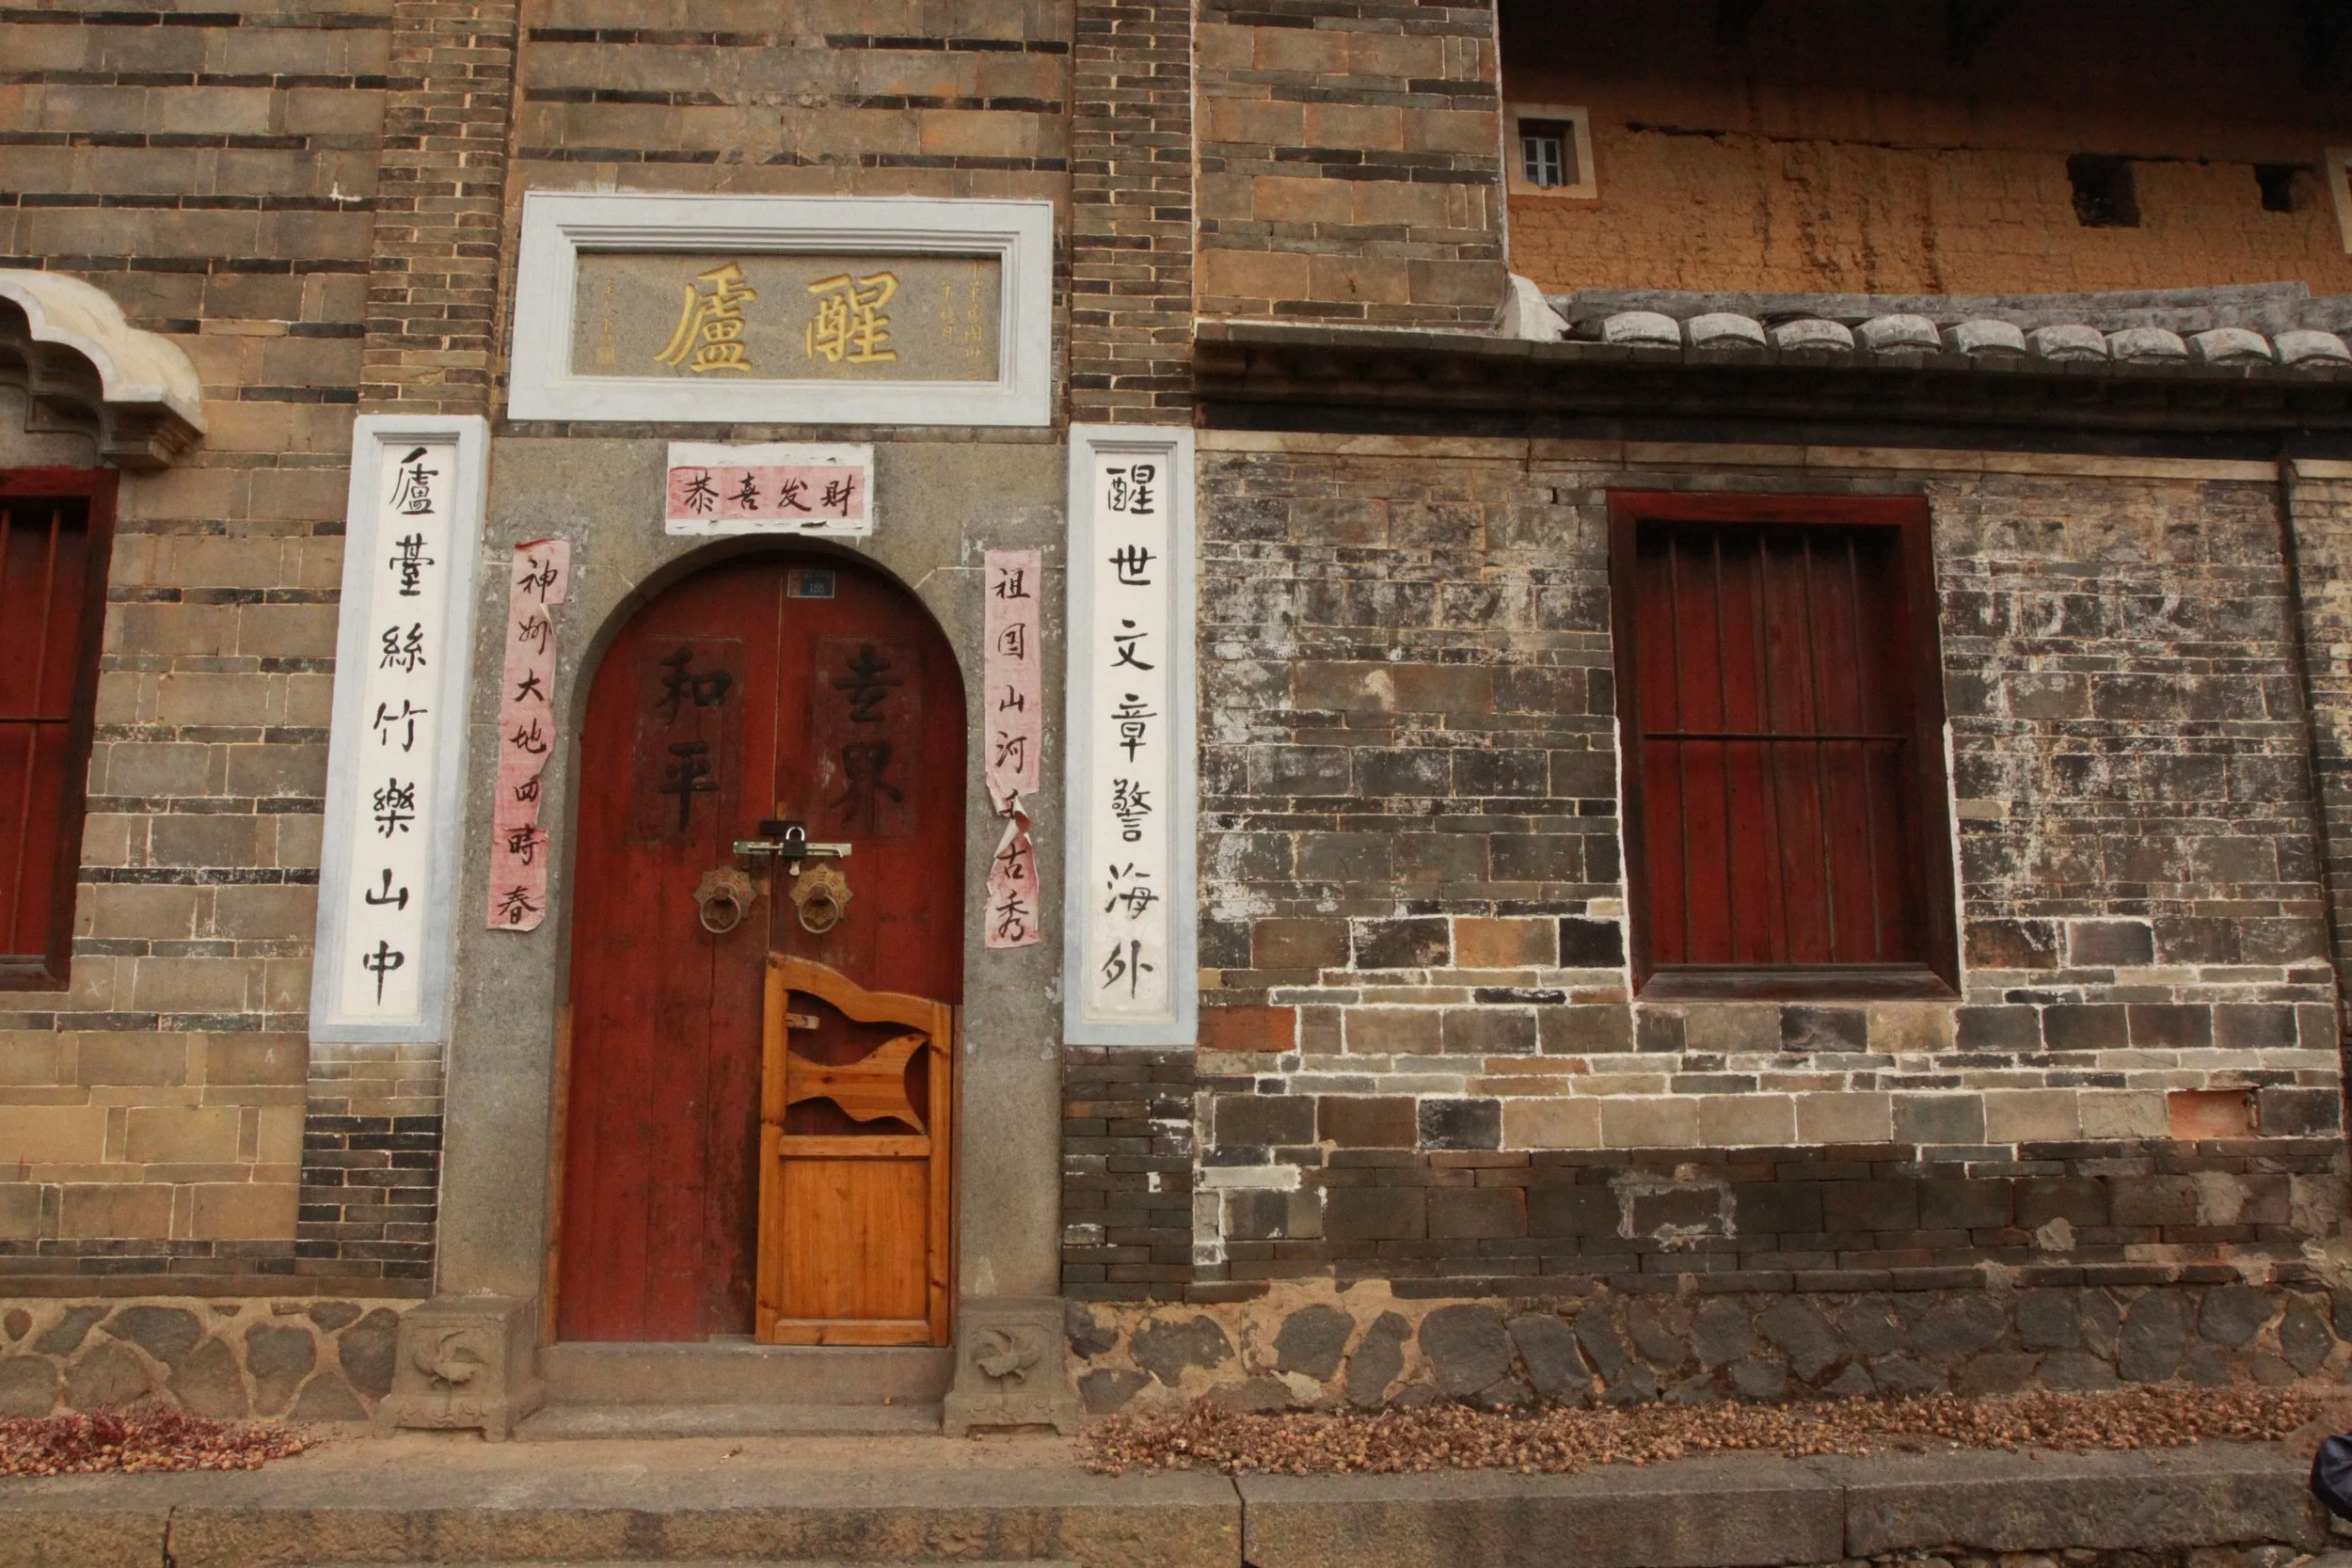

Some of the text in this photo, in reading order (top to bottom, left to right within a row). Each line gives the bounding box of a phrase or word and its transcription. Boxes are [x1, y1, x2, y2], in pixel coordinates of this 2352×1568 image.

[657, 646, 732, 832] 和平
[1102, 463, 1159, 1000] 醒世文章警海外
